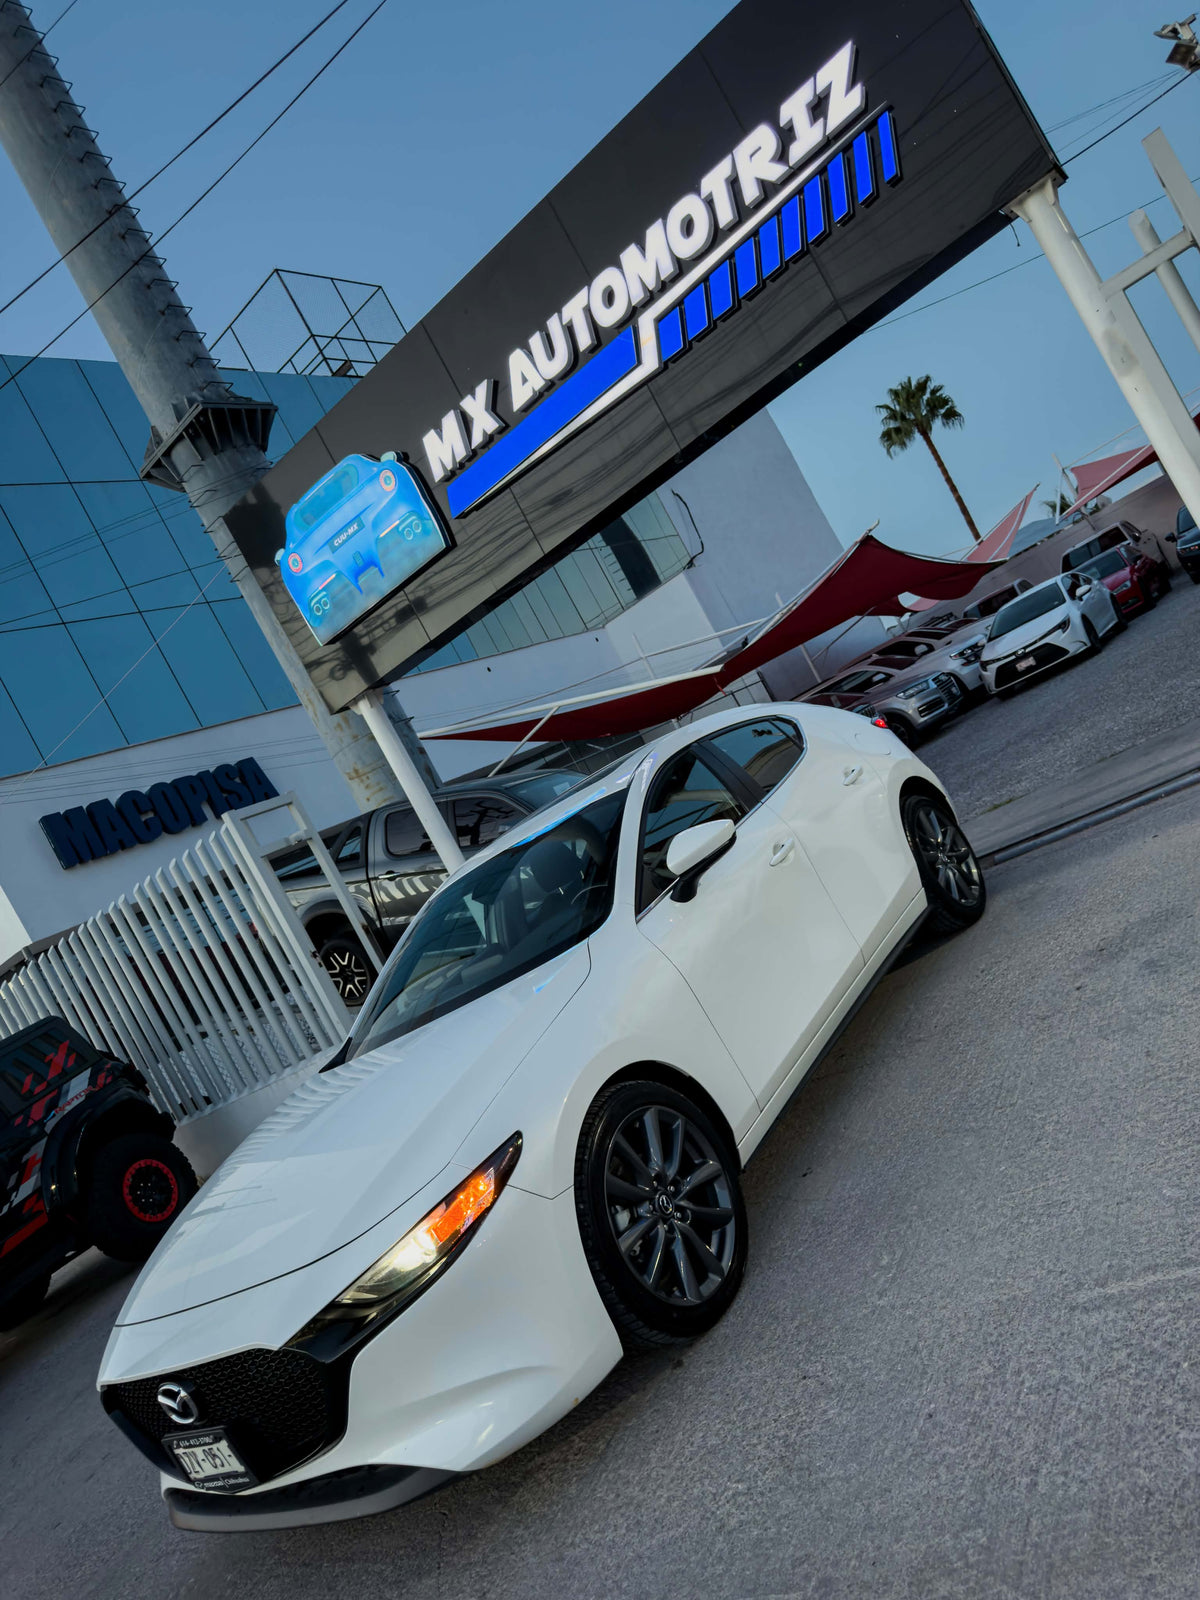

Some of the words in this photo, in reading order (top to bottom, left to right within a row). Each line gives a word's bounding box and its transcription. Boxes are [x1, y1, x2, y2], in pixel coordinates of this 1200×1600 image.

[422, 378, 504, 483] MX
[508, 40, 866, 412] AUTOMOTRIZ
[333, 522, 359, 547] CUU-MX
[39, 757, 279, 870] MACOPISA
[176, 1446, 232, 1475] DZY-051-
